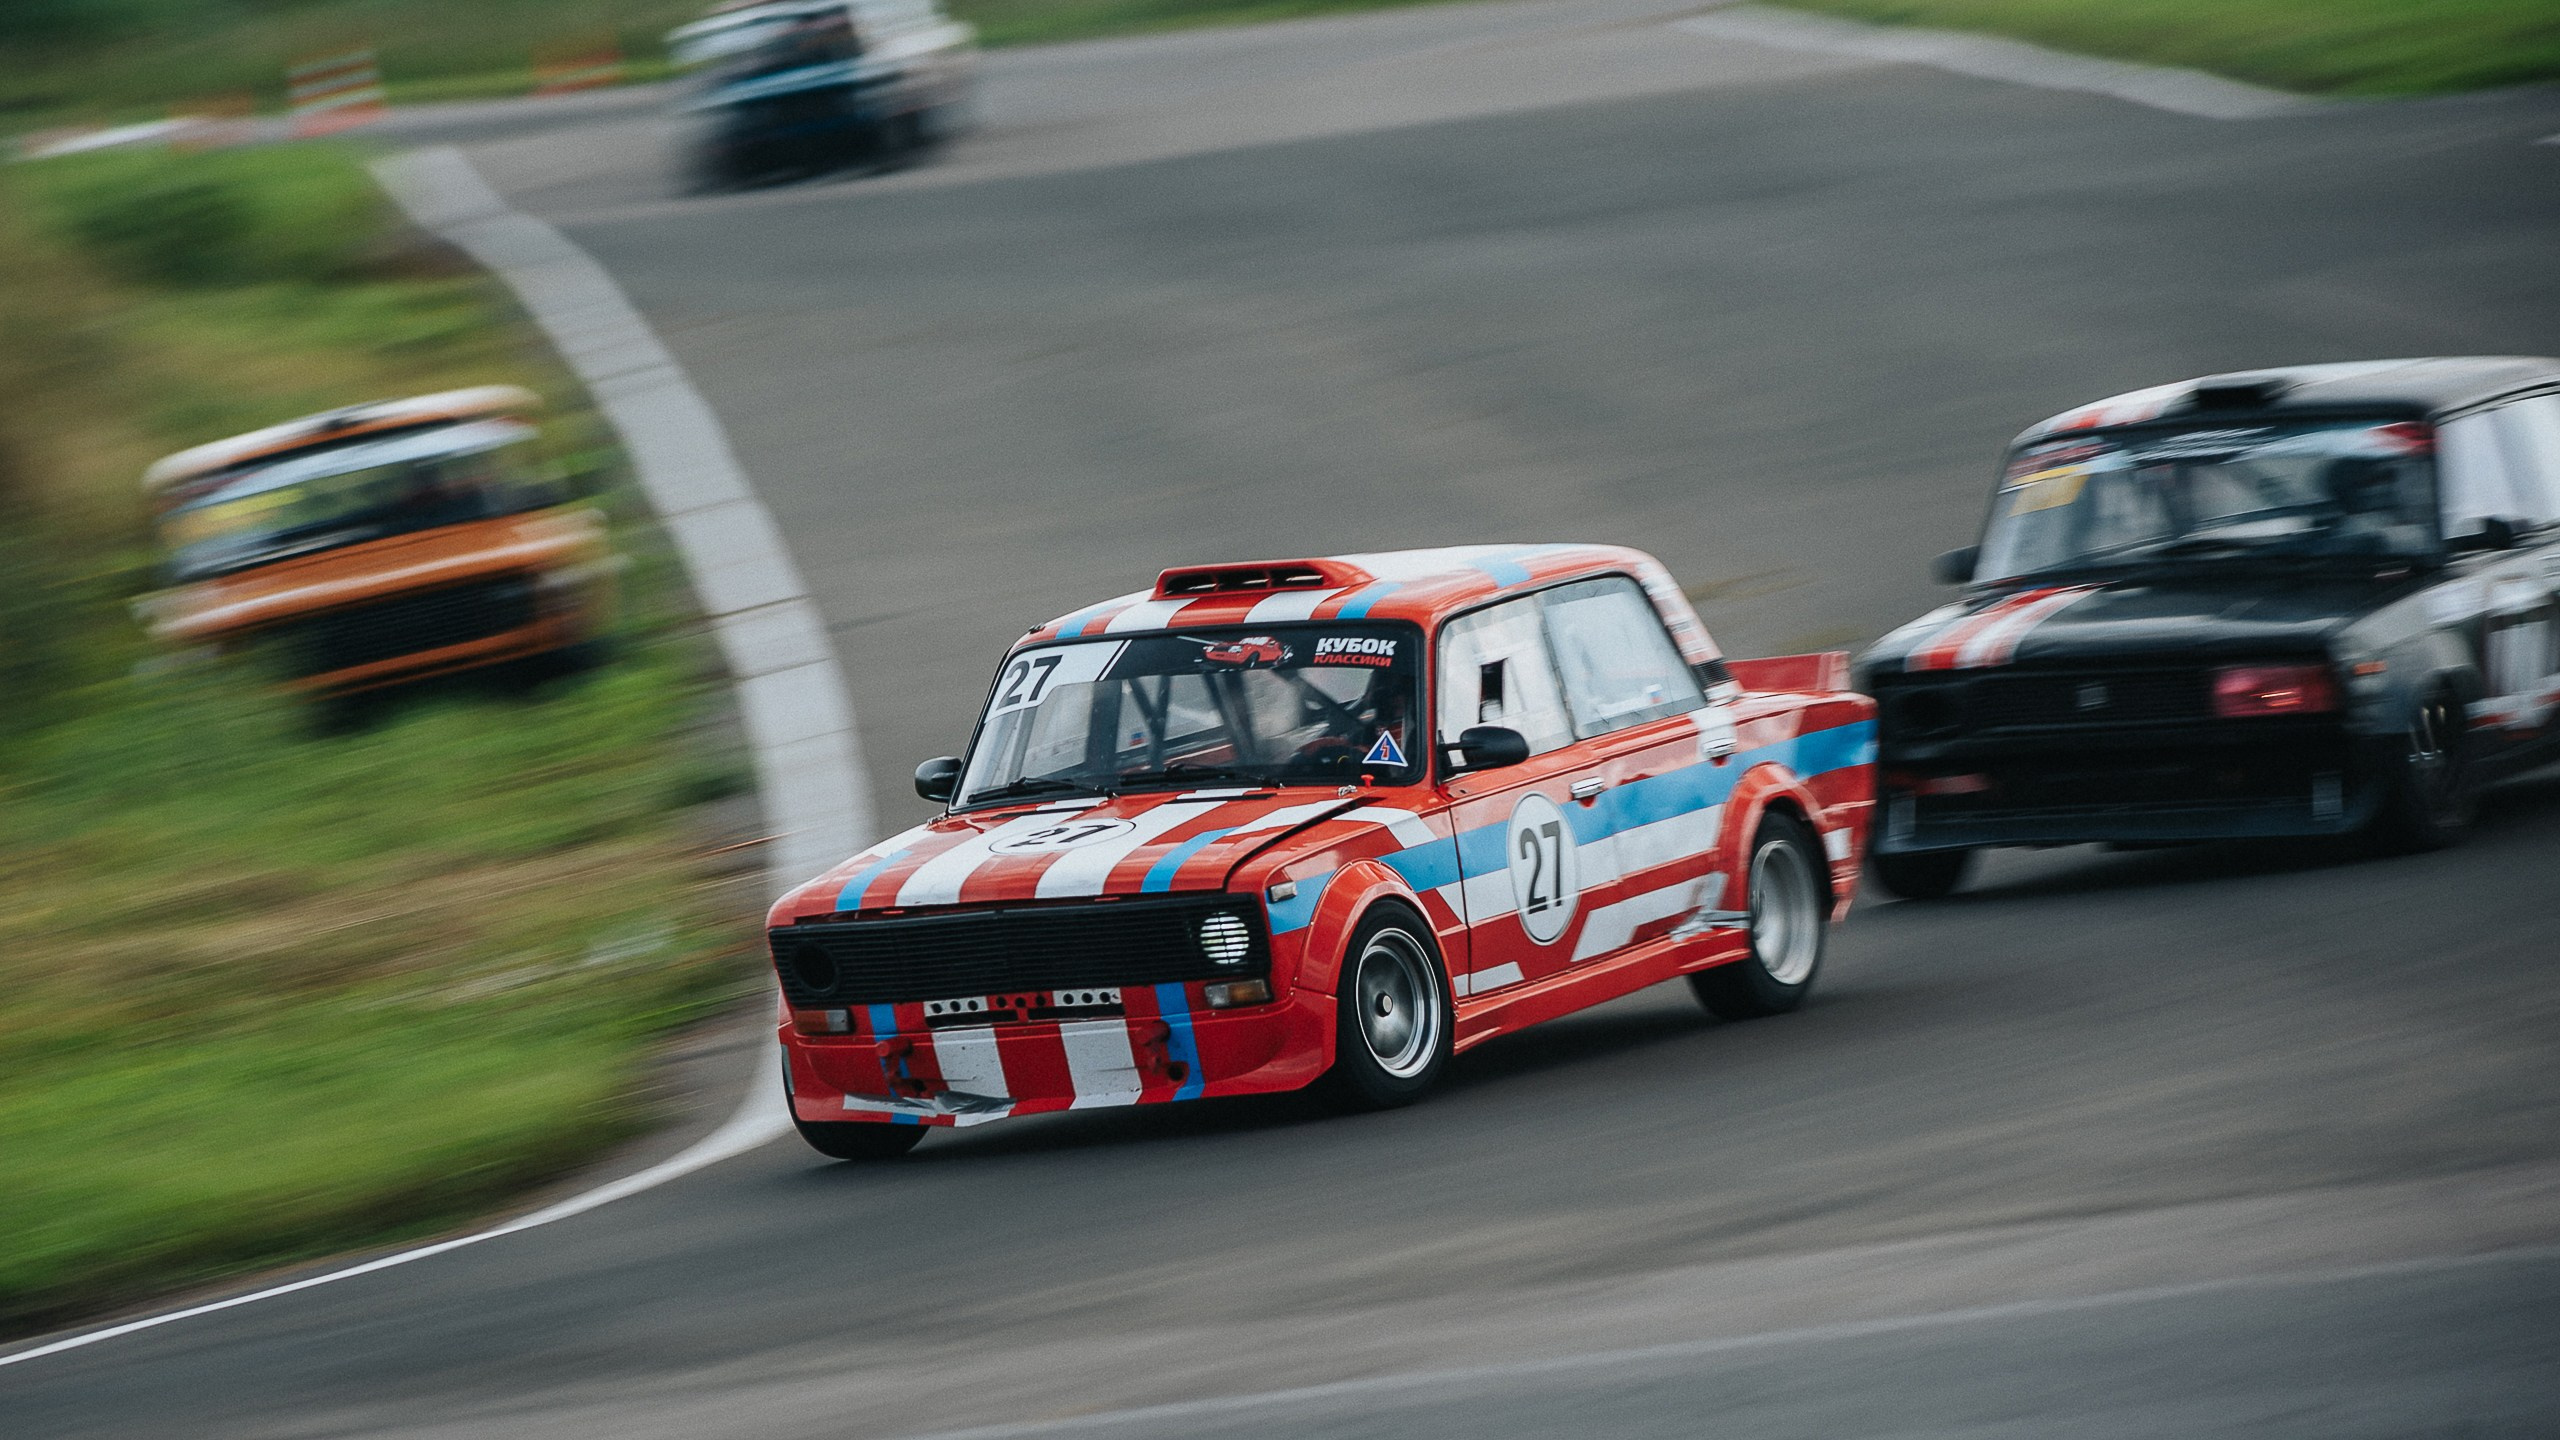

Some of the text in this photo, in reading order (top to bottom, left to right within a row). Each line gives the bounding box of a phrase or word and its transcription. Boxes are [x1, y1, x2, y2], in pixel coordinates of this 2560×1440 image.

[1316, 637, 1397, 656] КУБОК
[1314, 654, 1392, 668] КЛАССИКИ
[996, 654, 1063, 711] 27
[1006, 824, 1119, 848] 27
[1519, 820, 1562, 915] 27
